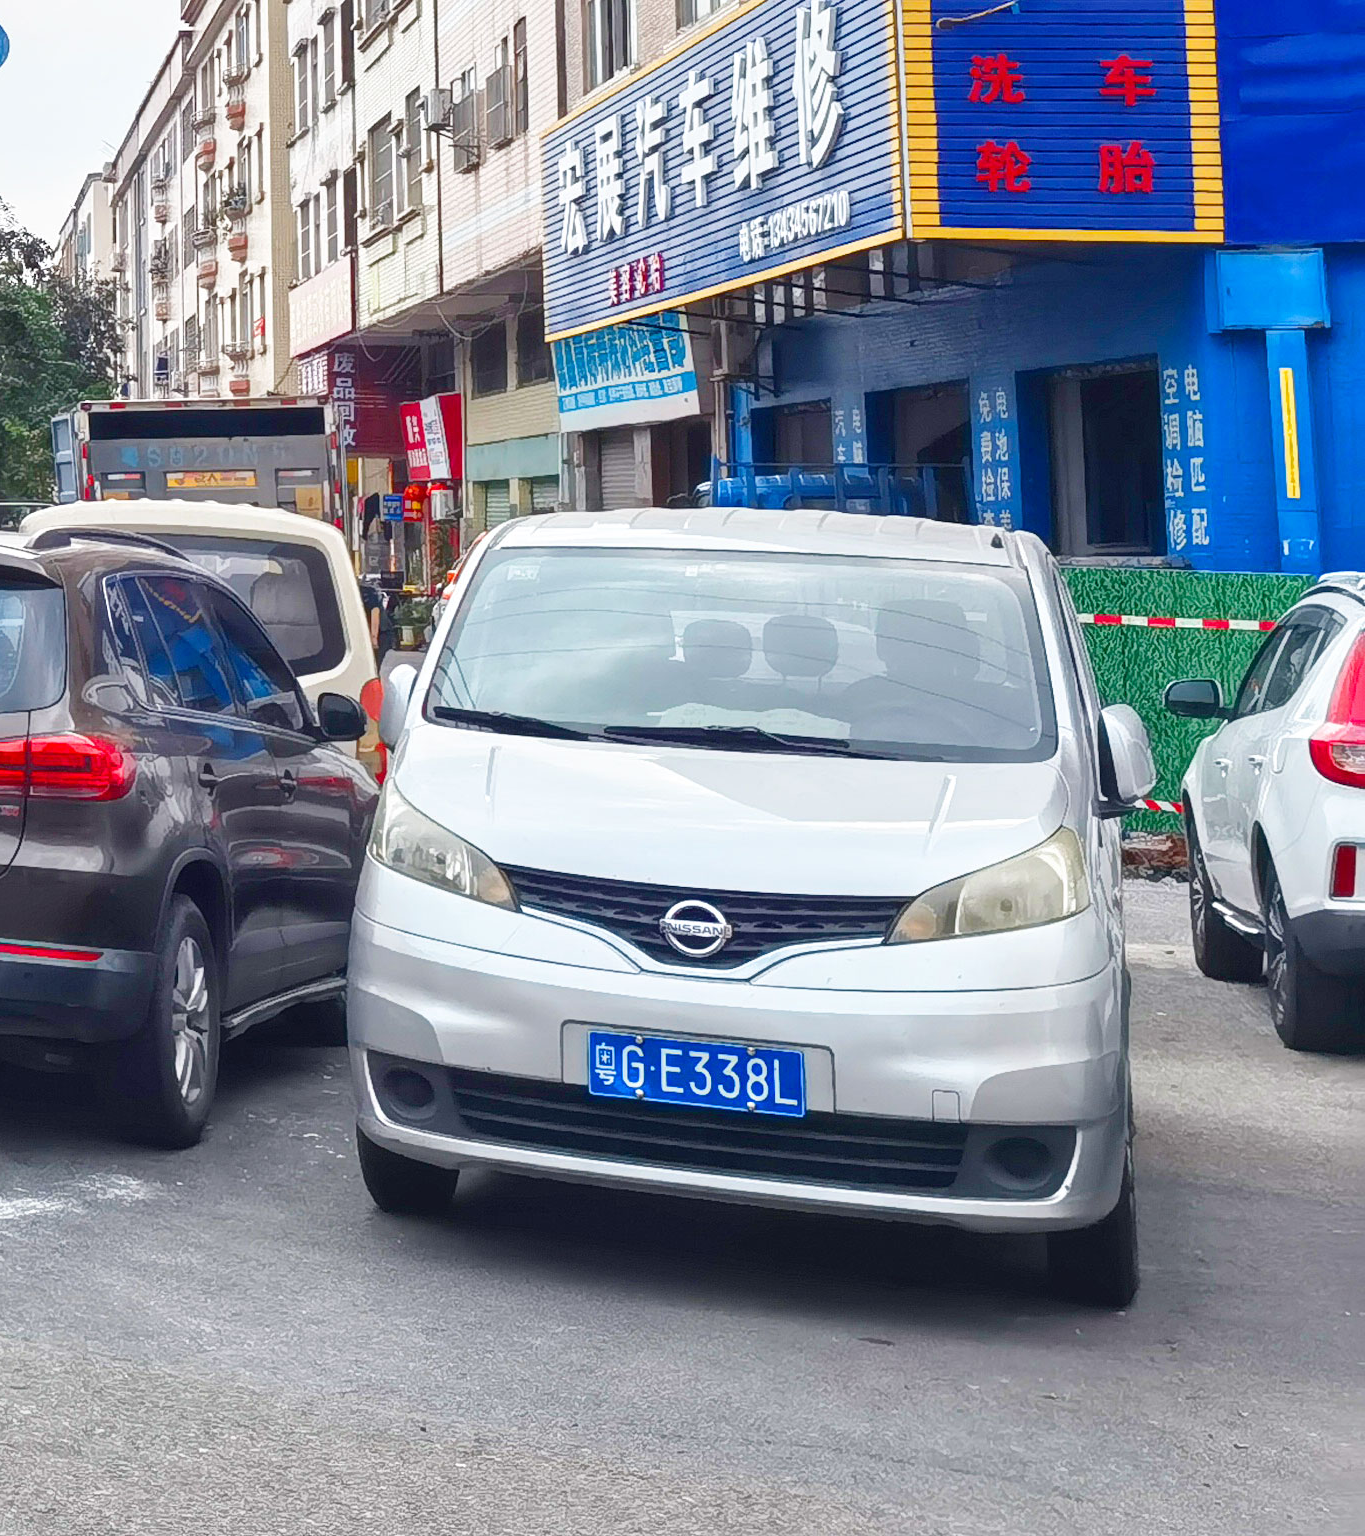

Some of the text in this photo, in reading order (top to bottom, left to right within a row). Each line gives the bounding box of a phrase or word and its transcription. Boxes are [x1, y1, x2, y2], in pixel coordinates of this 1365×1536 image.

[968, 53, 1157, 106] 洗车
[975, 140, 1156, 194] 轮胎
[665, 922, 724, 936] NISSAN
[594, 1041, 799, 1107] 粤G·E338L
